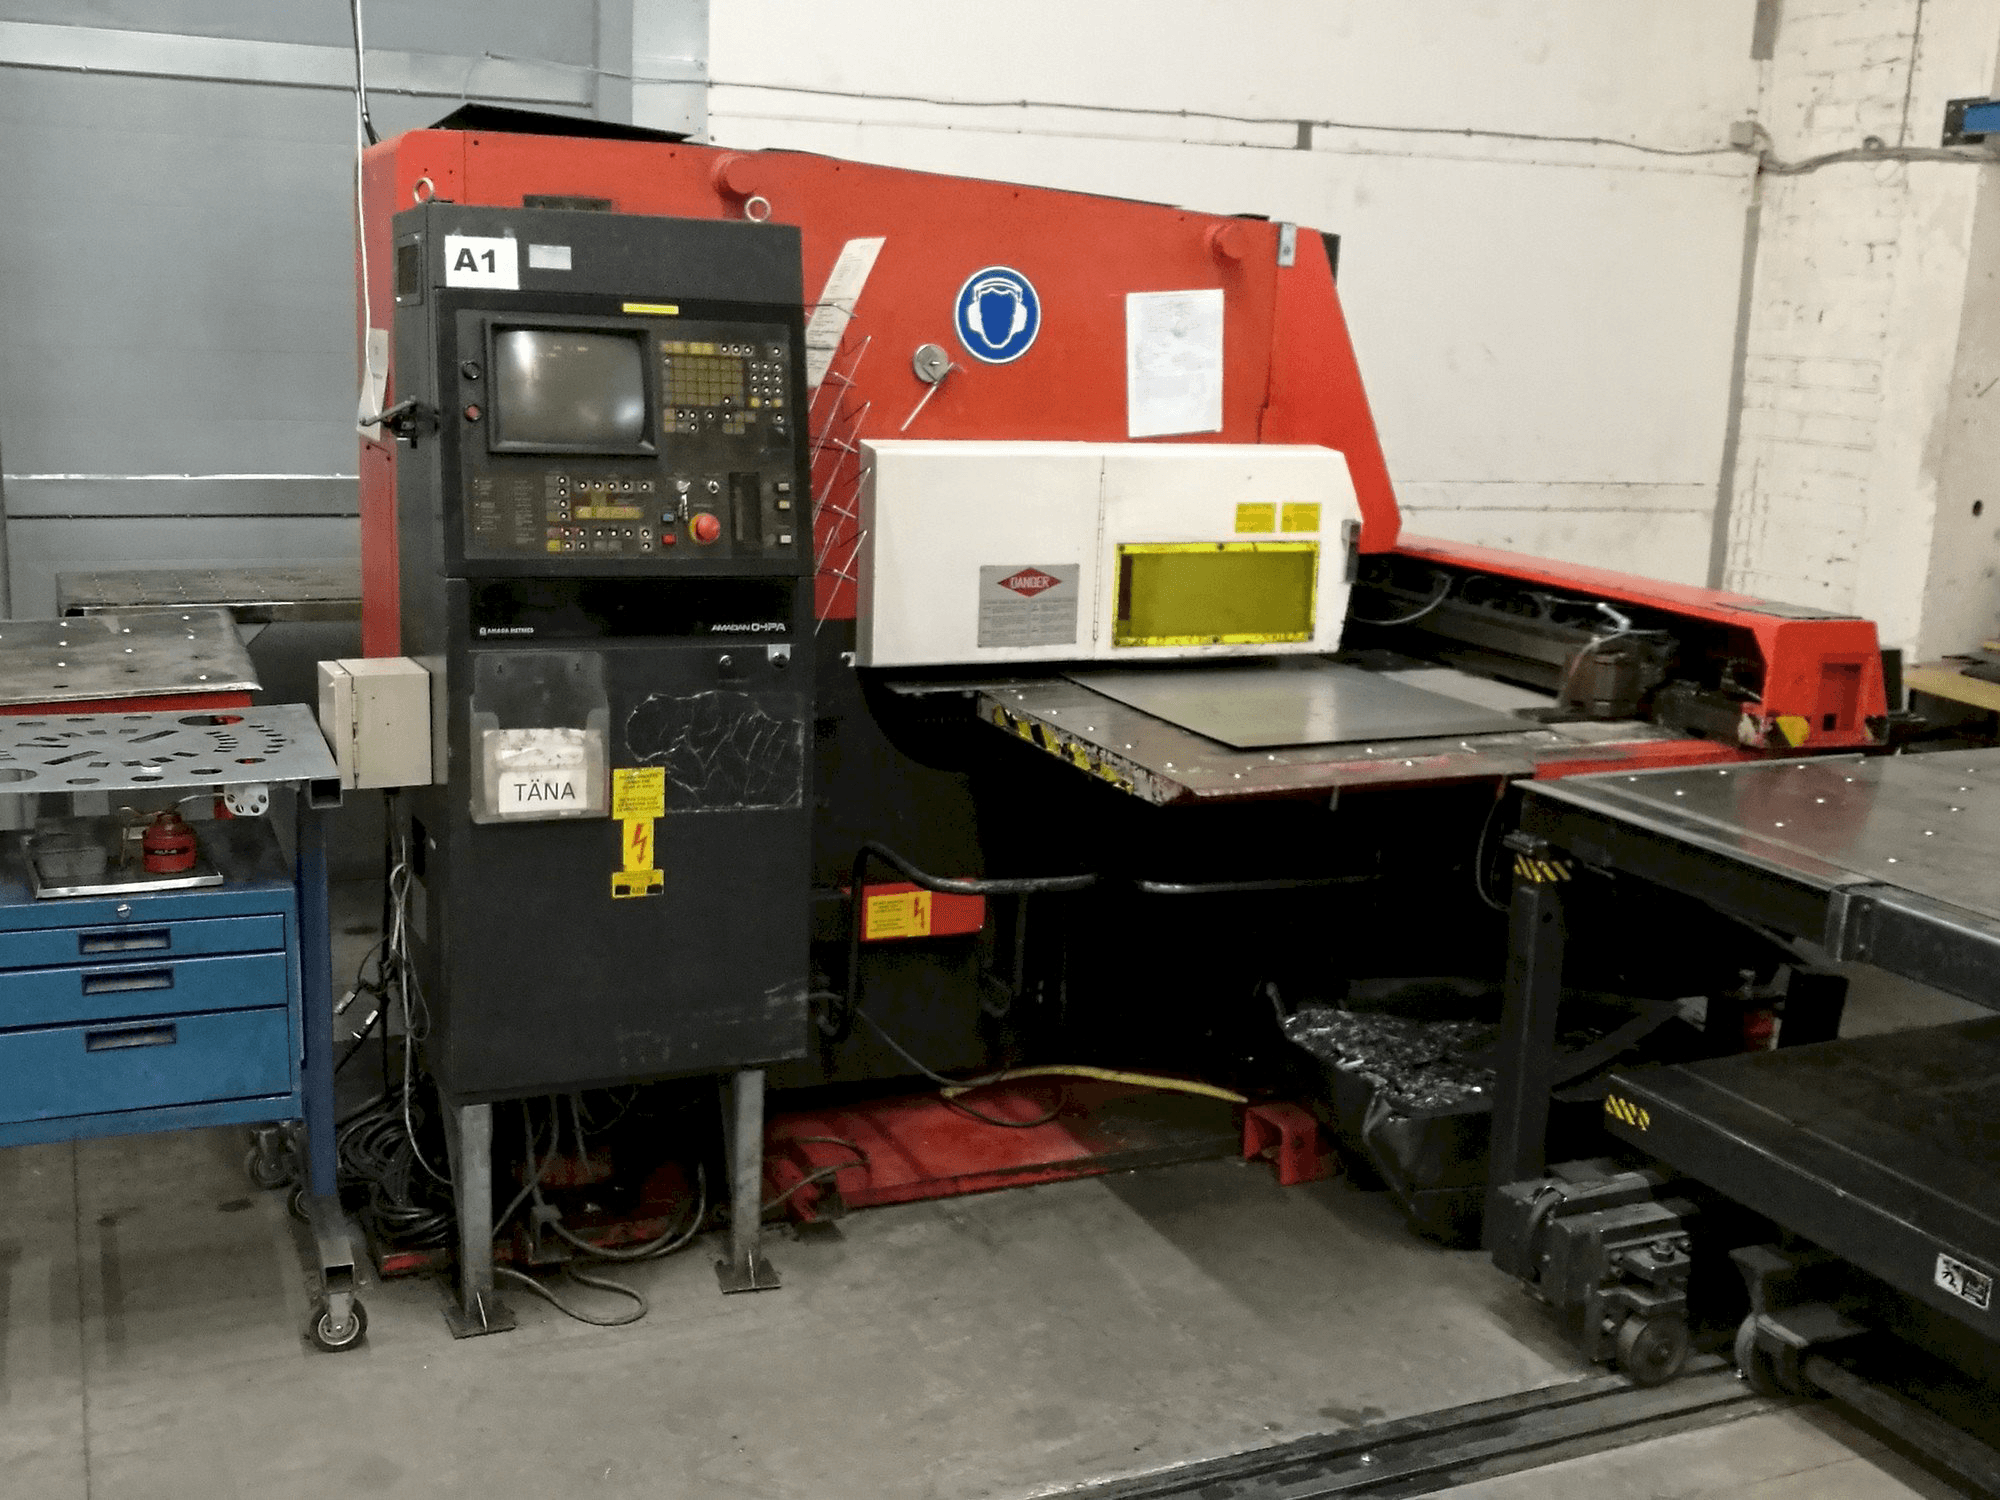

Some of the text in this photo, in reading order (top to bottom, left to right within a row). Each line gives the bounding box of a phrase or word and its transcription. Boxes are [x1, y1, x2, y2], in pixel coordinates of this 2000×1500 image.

[454, 248, 495, 273] A1
[1010, 576, 1050, 588] DANGER
[513, 778, 576, 801] TÄNA
